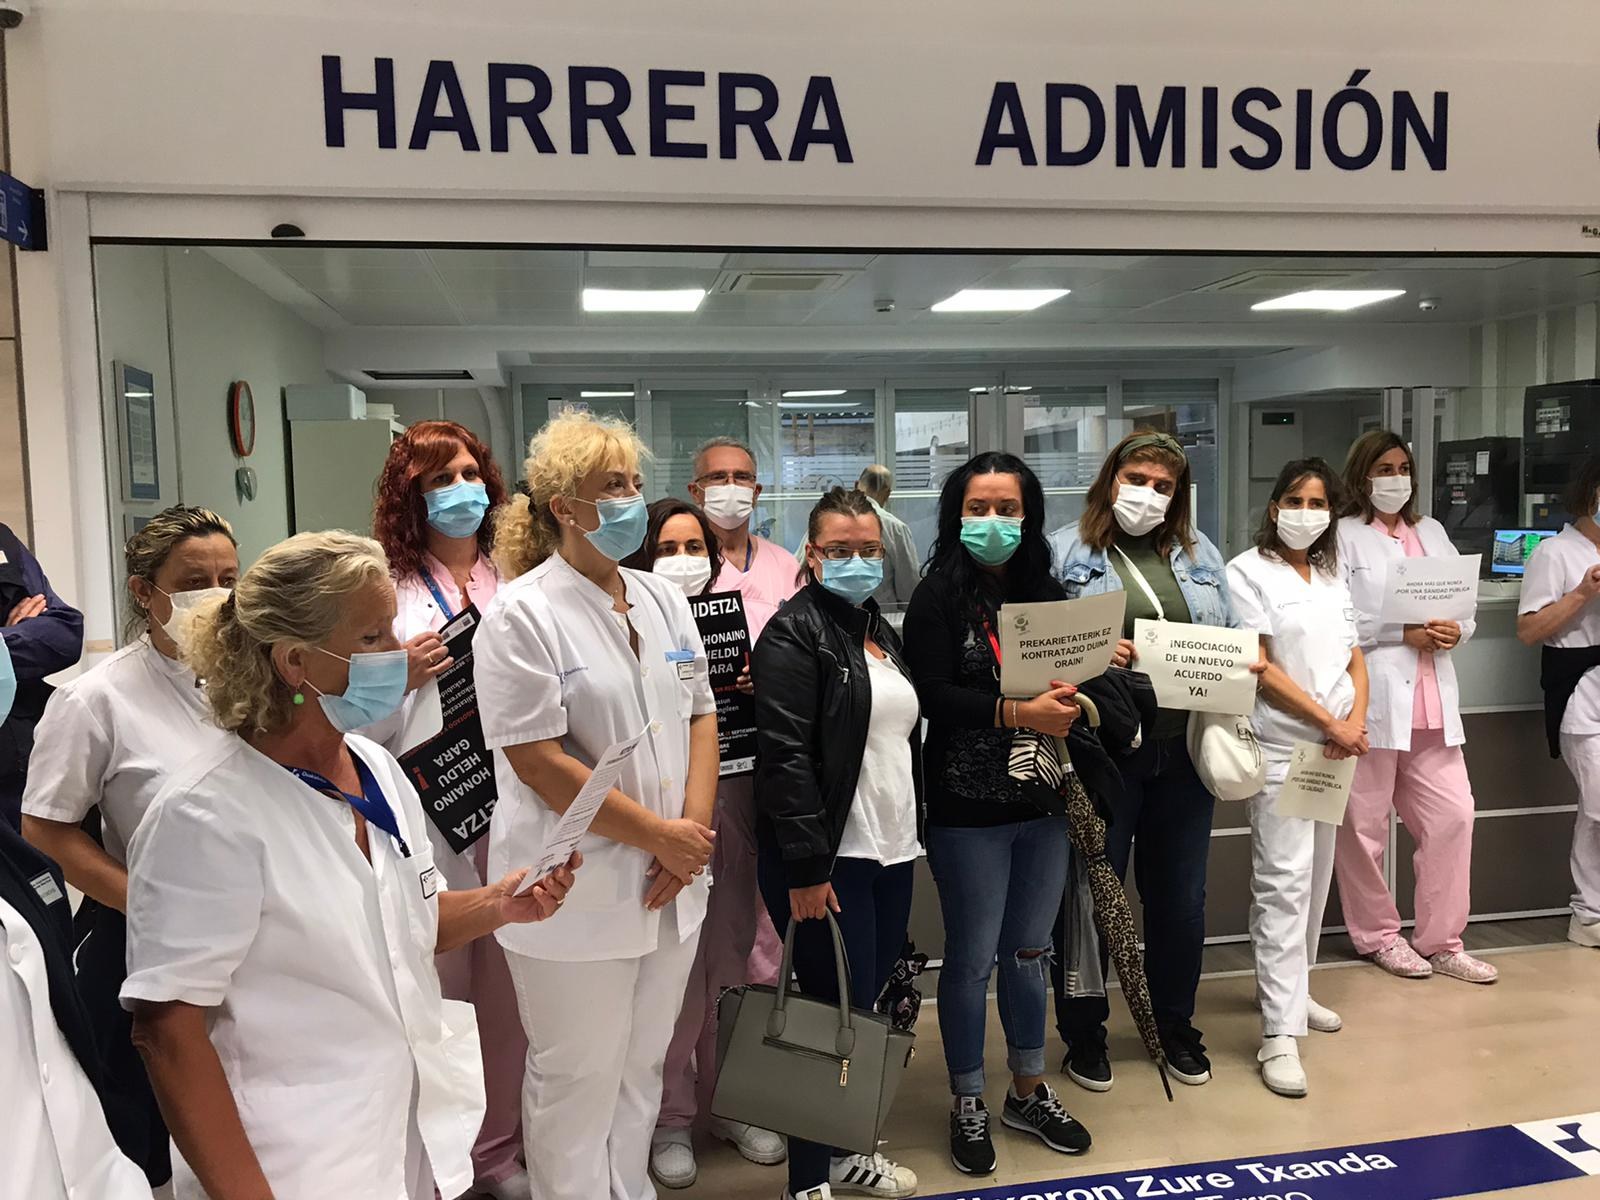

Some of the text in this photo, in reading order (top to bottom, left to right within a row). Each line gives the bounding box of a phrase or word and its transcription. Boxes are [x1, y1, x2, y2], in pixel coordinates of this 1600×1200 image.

[321, 54, 1449, 172] HARRERA ADMISIÓN
[692, 597, 741, 619] IDETZA
[702, 629, 746, 646] HONAINO
[1019, 626, 1112, 648] PREKARIETATERIK EZ
[1022, 644, 1086, 660] KONTRATAZIO
[1170, 640, 1242, 654] ¡NEGOCIACIÓN
[709, 662, 735, 676] ARA
[1054, 656, 1084, 668] ORAIN!
[1165, 653, 1234, 668] DE UN NUEVO
[1174, 669, 1222, 682] ACUERDO
[1188, 686, 1208, 698] YA!
[432, 738, 471, 768] GARA
[437, 752, 482, 788] HELDU
[433, 766, 492, 812] HONAINO
[1124, 1172, 1235, 1199] Zure
[1235, 1152, 1398, 1184] Txanda
